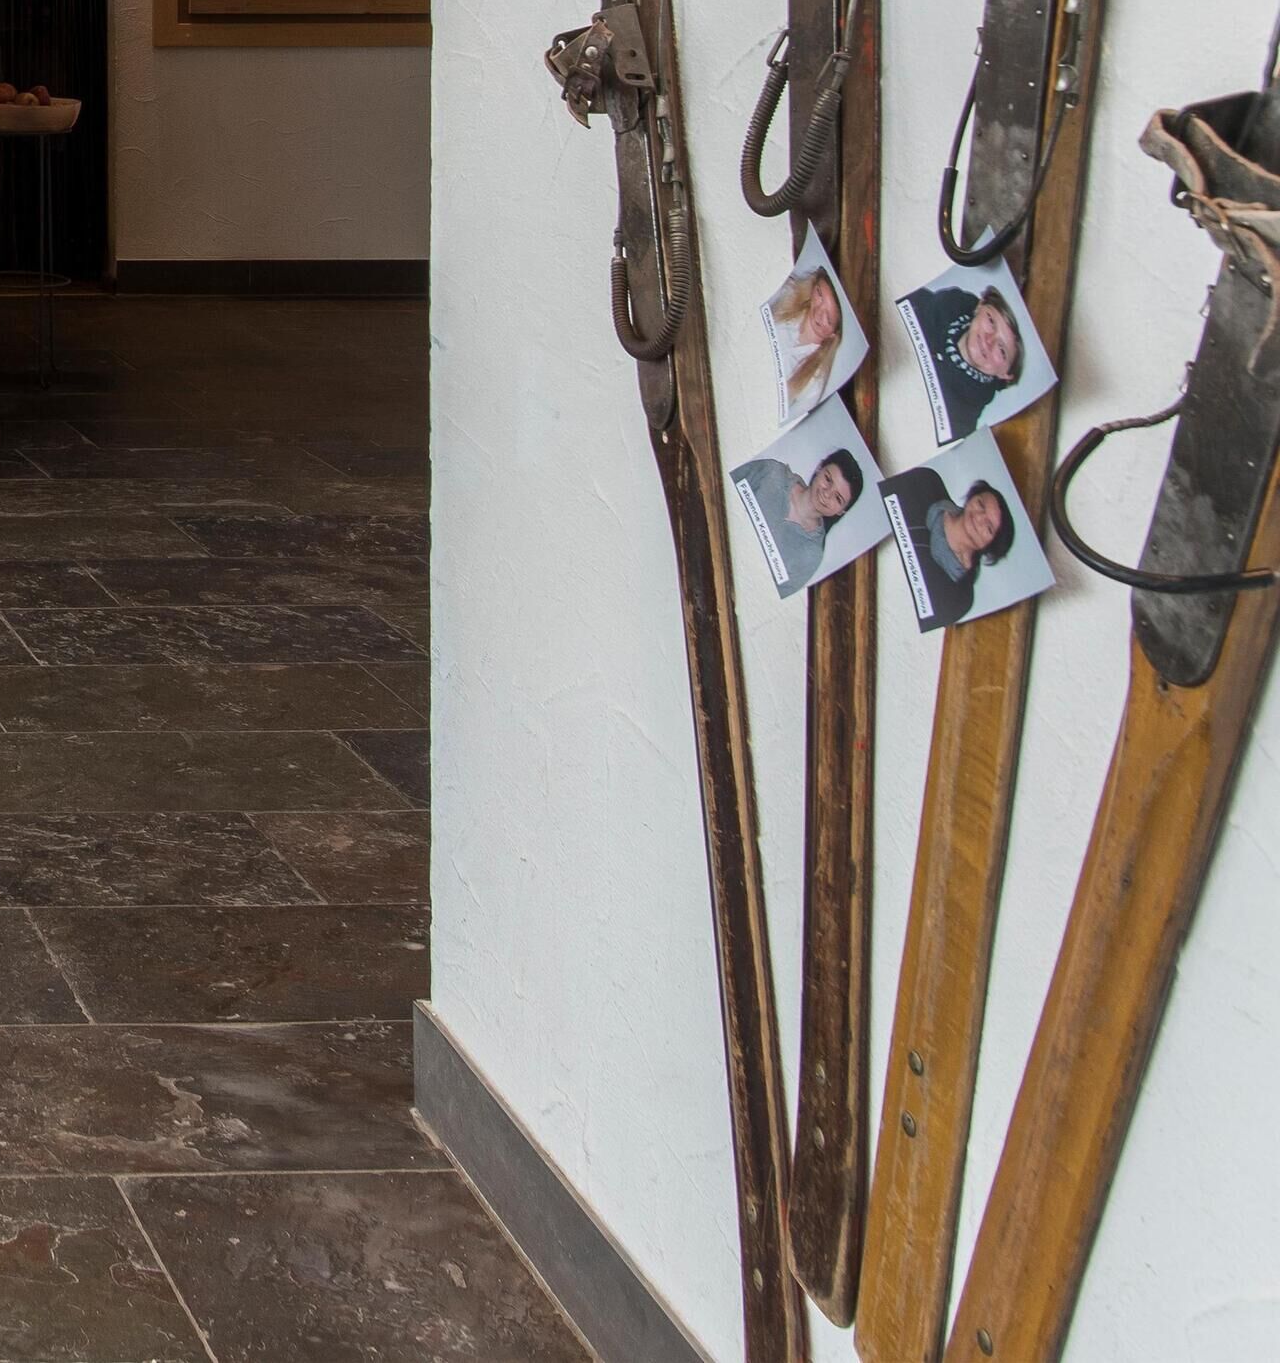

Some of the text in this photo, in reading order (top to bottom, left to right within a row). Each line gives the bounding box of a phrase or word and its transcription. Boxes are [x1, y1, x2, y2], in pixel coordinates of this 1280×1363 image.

[902, 304, 920, 341] Ricarda
[740, 483, 775, 558] Fabienne Knecht,
[889, 499, 909, 549] Alexandra
